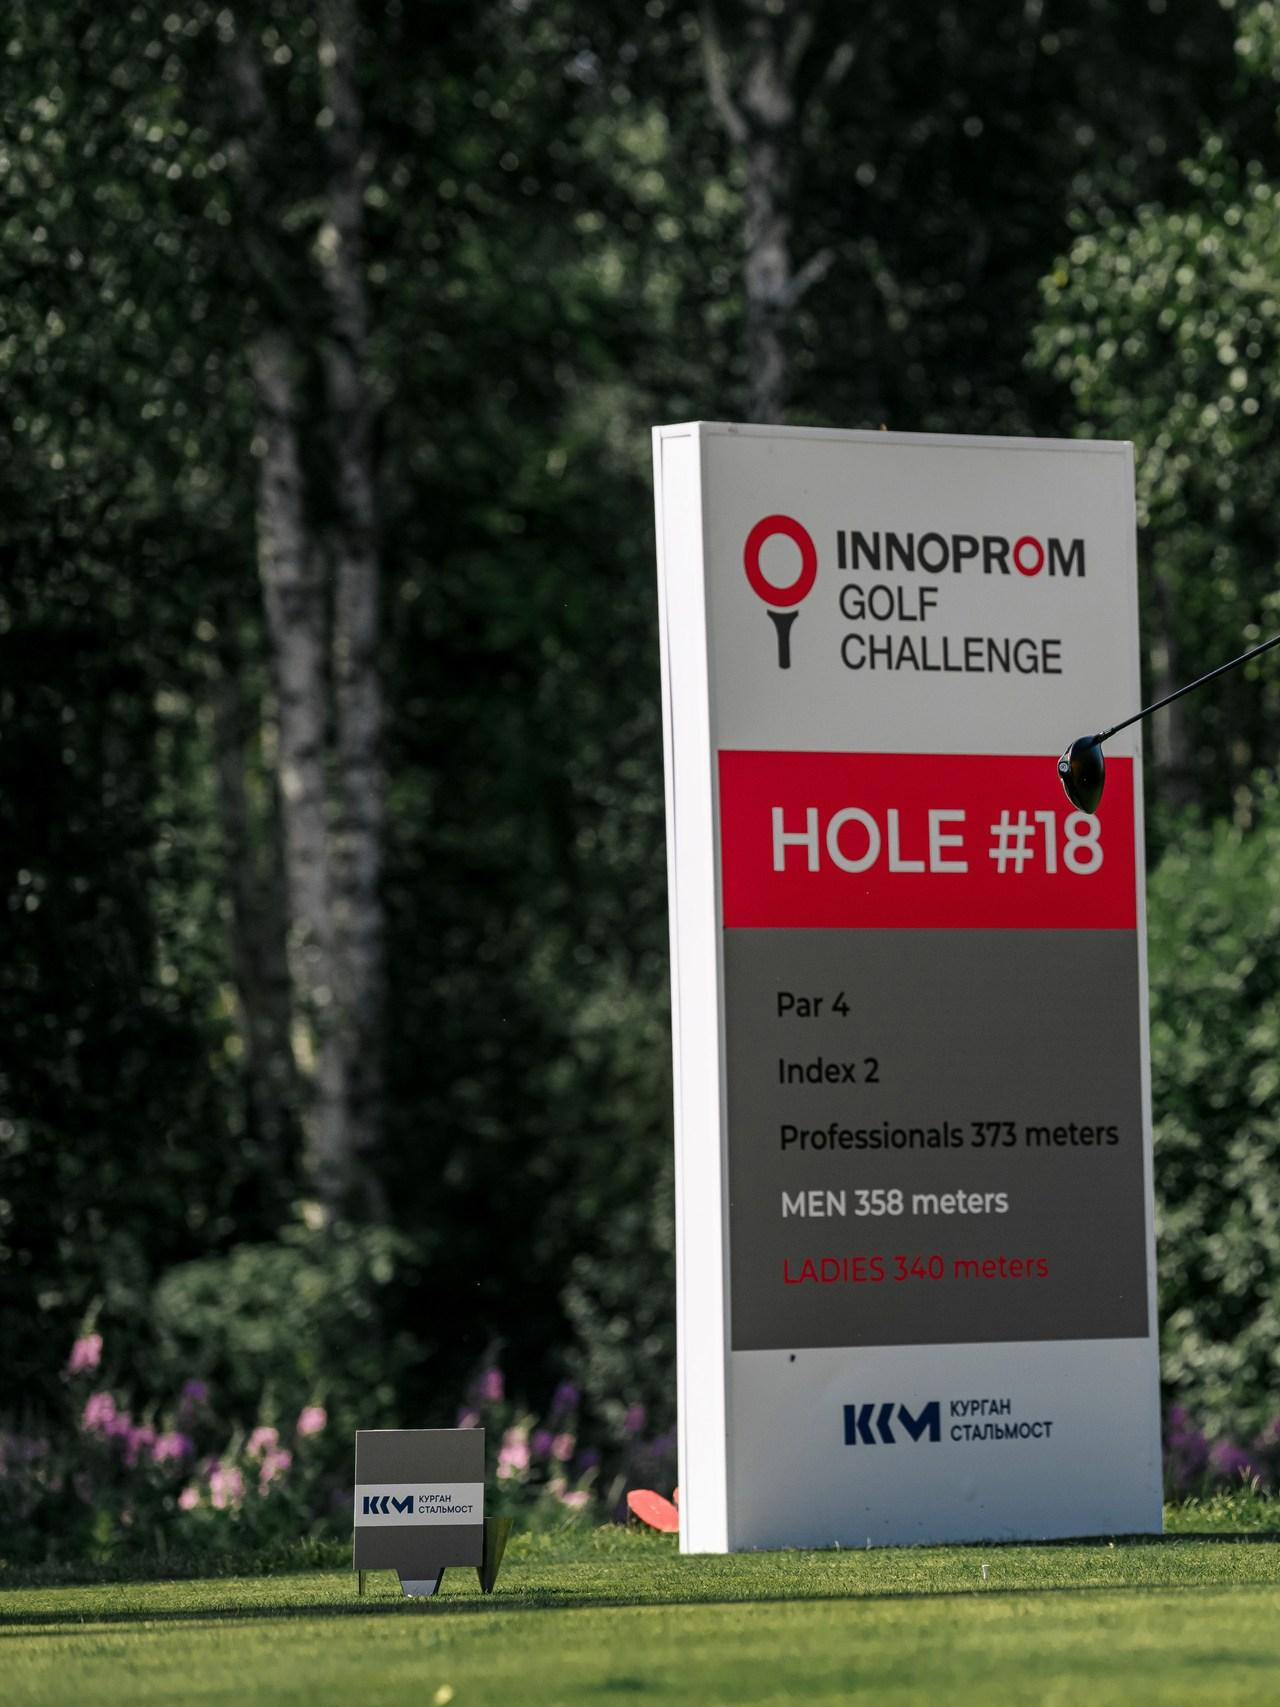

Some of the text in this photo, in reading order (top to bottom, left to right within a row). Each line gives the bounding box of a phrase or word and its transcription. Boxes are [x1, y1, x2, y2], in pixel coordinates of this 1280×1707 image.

[837, 530, 1085, 577] INNOPROM
[839, 584, 938, 621] GOLF
[841, 633, 1062, 674] CHALLENGE
[772, 807, 1103, 874] HOLE #18
[778, 992, 850, 1017] Par 4
[779, 1057, 879, 1084] Index 2
[781, 1121, 1119, 1150] Professionals 373 meters
[782, 1189, 1008, 1217] MEN 358 meters
[783, 1254, 1049, 1285] LADIES 340 meters
[951, 1399, 1010, 1416] КУРГАН
[951, 1421, 1052, 1441] СТАЛЬМОСТ
[418, 1494, 452, 1503] КУРГАН
[418, 1504, 473, 1514] СТАЛЬМОСТ
